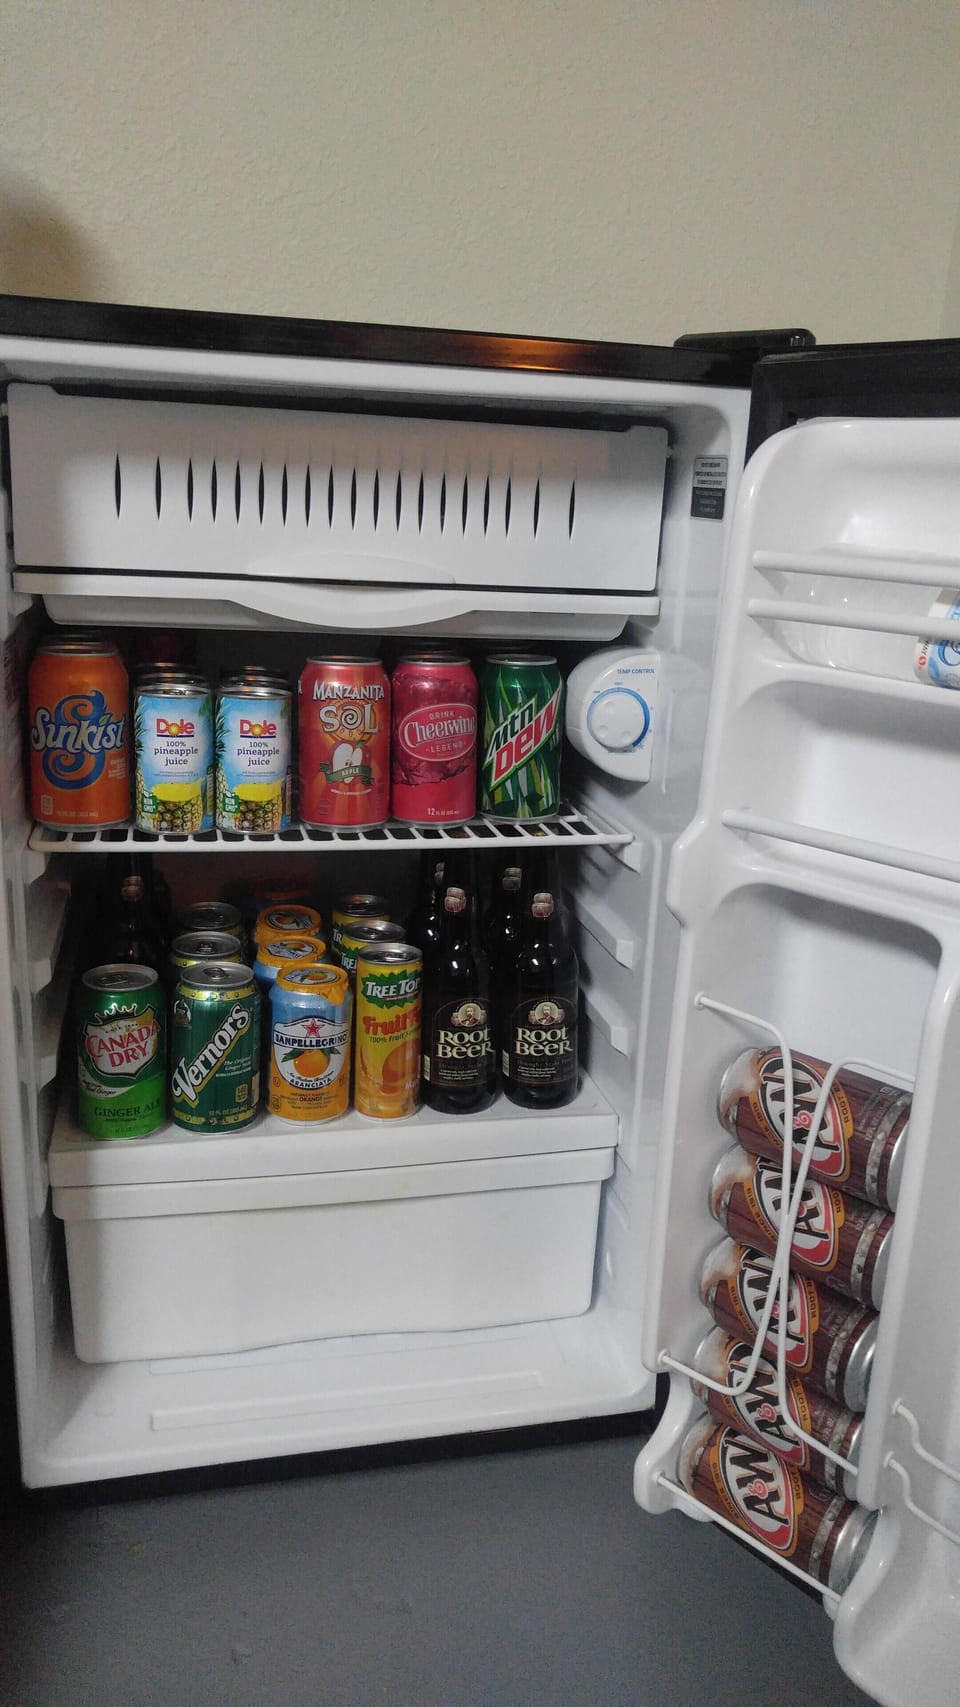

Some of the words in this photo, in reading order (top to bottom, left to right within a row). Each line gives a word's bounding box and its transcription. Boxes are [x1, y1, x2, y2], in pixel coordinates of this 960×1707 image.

[313, 680, 384, 700] MANZANITA
[320, 704, 379, 733] SOL
[429, 710, 454, 720] DRINK
[31, 706, 124, 753] Sunkist
[156, 718, 195, 736] Dole
[240, 719, 277, 736] Dole
[154, 747, 199, 756] pineapple
[237, 747, 280, 757] pineapple
[430, 742, 464, 753] LEGEND
[165, 757, 188, 766] juice
[248, 758, 270, 766] juice
[341, 767, 360, 776] APPLE
[366, 981, 398, 999] TREE
[86, 1021, 161, 1058] CANADA
[108, 1041, 149, 1068] DRY
[172, 1004, 250, 1101] Vernors
[289, 1077, 332, 1088] ARANCIATA
[95, 1106, 140, 1118] GINGER
[730, 1361, 801, 1446] A&W
[725, 1438, 790, 1525] A&W
